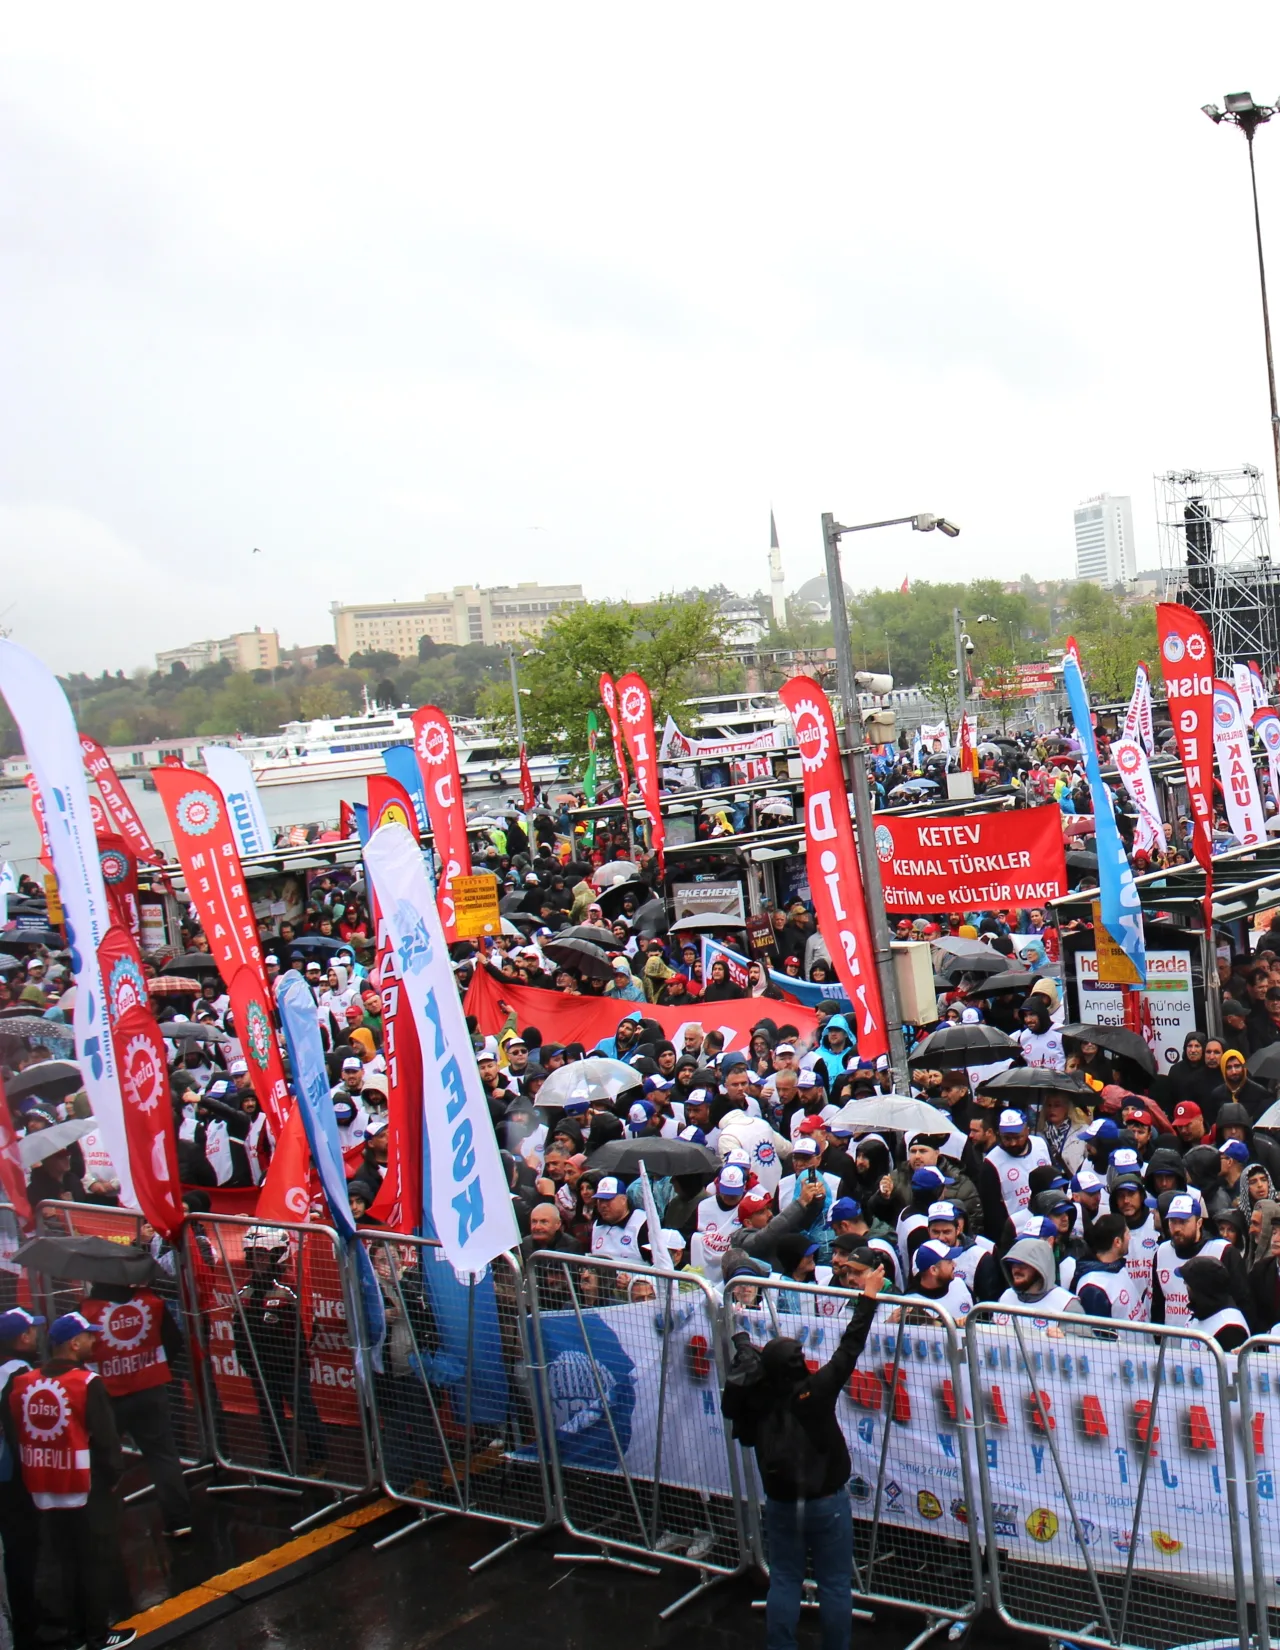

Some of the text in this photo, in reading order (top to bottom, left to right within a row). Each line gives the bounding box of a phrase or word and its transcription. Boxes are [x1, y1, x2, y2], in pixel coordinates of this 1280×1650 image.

[918, 824, 981, 847] KETEV
[893, 851, 1031, 876] KEMAL TÜRKLER
[677, 887, 740, 898] SKECHERS
[927, 893, 946, 905] ve
[948, 885, 1011, 904] KÜLTÜR
[1015, 882, 1059, 899] VAKFI
[1094, 981, 1115, 990] Moda
[1084, 999, 1191, 1012] Annele ünü'nde
[111, 1312, 143, 1332] DİSK
[103, 1353, 157, 1377] GÖREVLİ
[28, 1397, 59, 1418] DİSK
